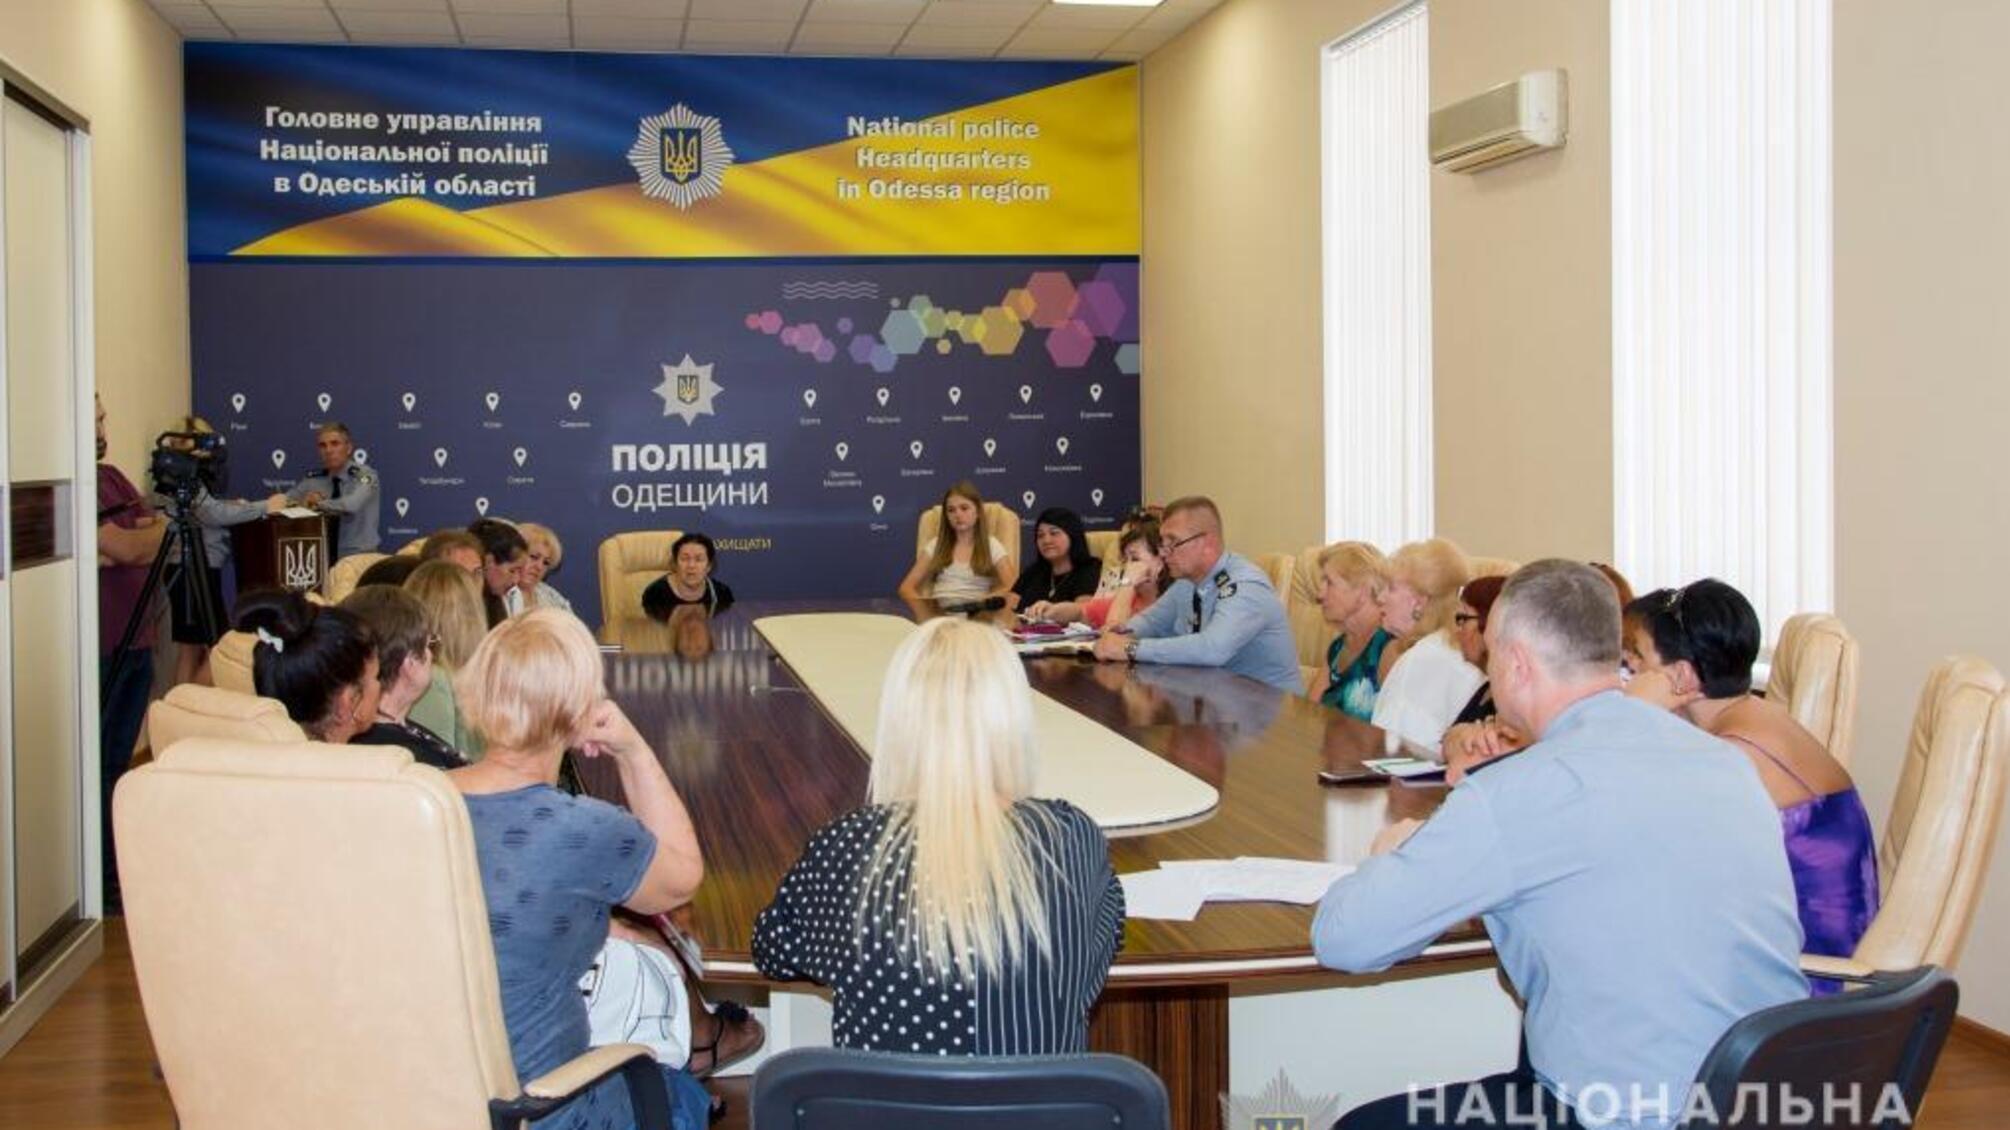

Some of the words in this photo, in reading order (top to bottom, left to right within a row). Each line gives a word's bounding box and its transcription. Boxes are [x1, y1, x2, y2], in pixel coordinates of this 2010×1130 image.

[265, 106, 379, 129] Головне
[386, 110, 542, 134] управління
[847, 116, 955, 137] National
[963, 118, 1039, 141] police
[260, 139, 451, 164] Національної
[458, 143, 549, 167] поліції
[857, 146, 1031, 171] Headquarters
[274, 176, 291, 193] в
[298, 171, 426, 196] Одеській
[434, 173, 536, 196] області
[838, 179, 860, 198] in
[868, 177, 962, 199] Odessa
[971, 180, 1050, 203] region
[612, 443, 767, 475] ПОЛІЦІЯ
[612, 482, 768, 513] ОДЕЩИНИ
